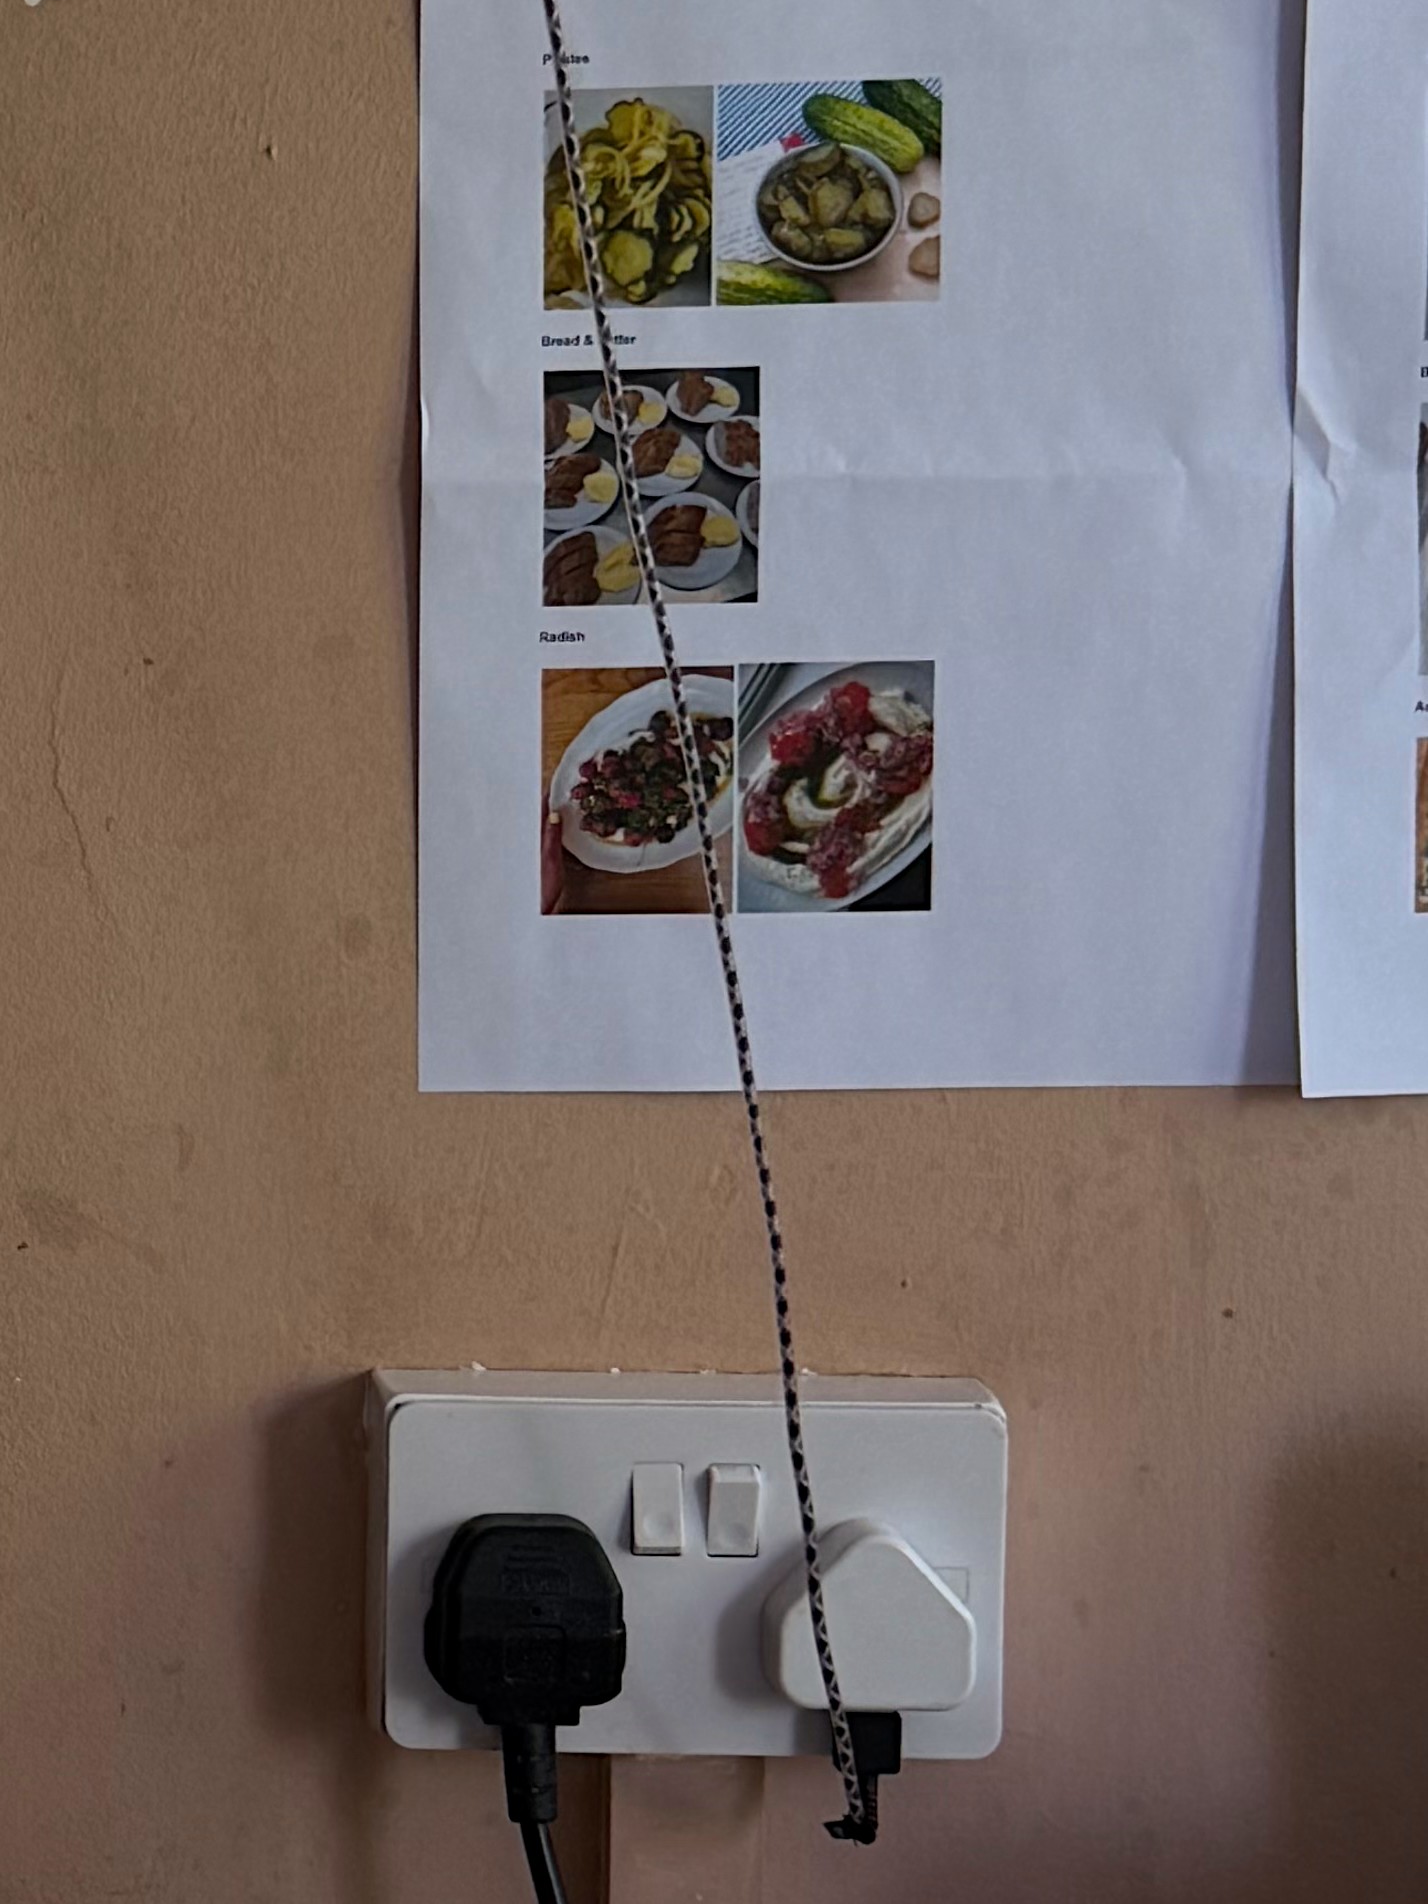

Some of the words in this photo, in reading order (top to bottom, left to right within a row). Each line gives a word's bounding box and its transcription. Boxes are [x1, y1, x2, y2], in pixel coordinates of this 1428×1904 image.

[541, 335, 580, 347] Bread
[583, 335, 594, 346] &
[539, 631, 585, 643] Radish
